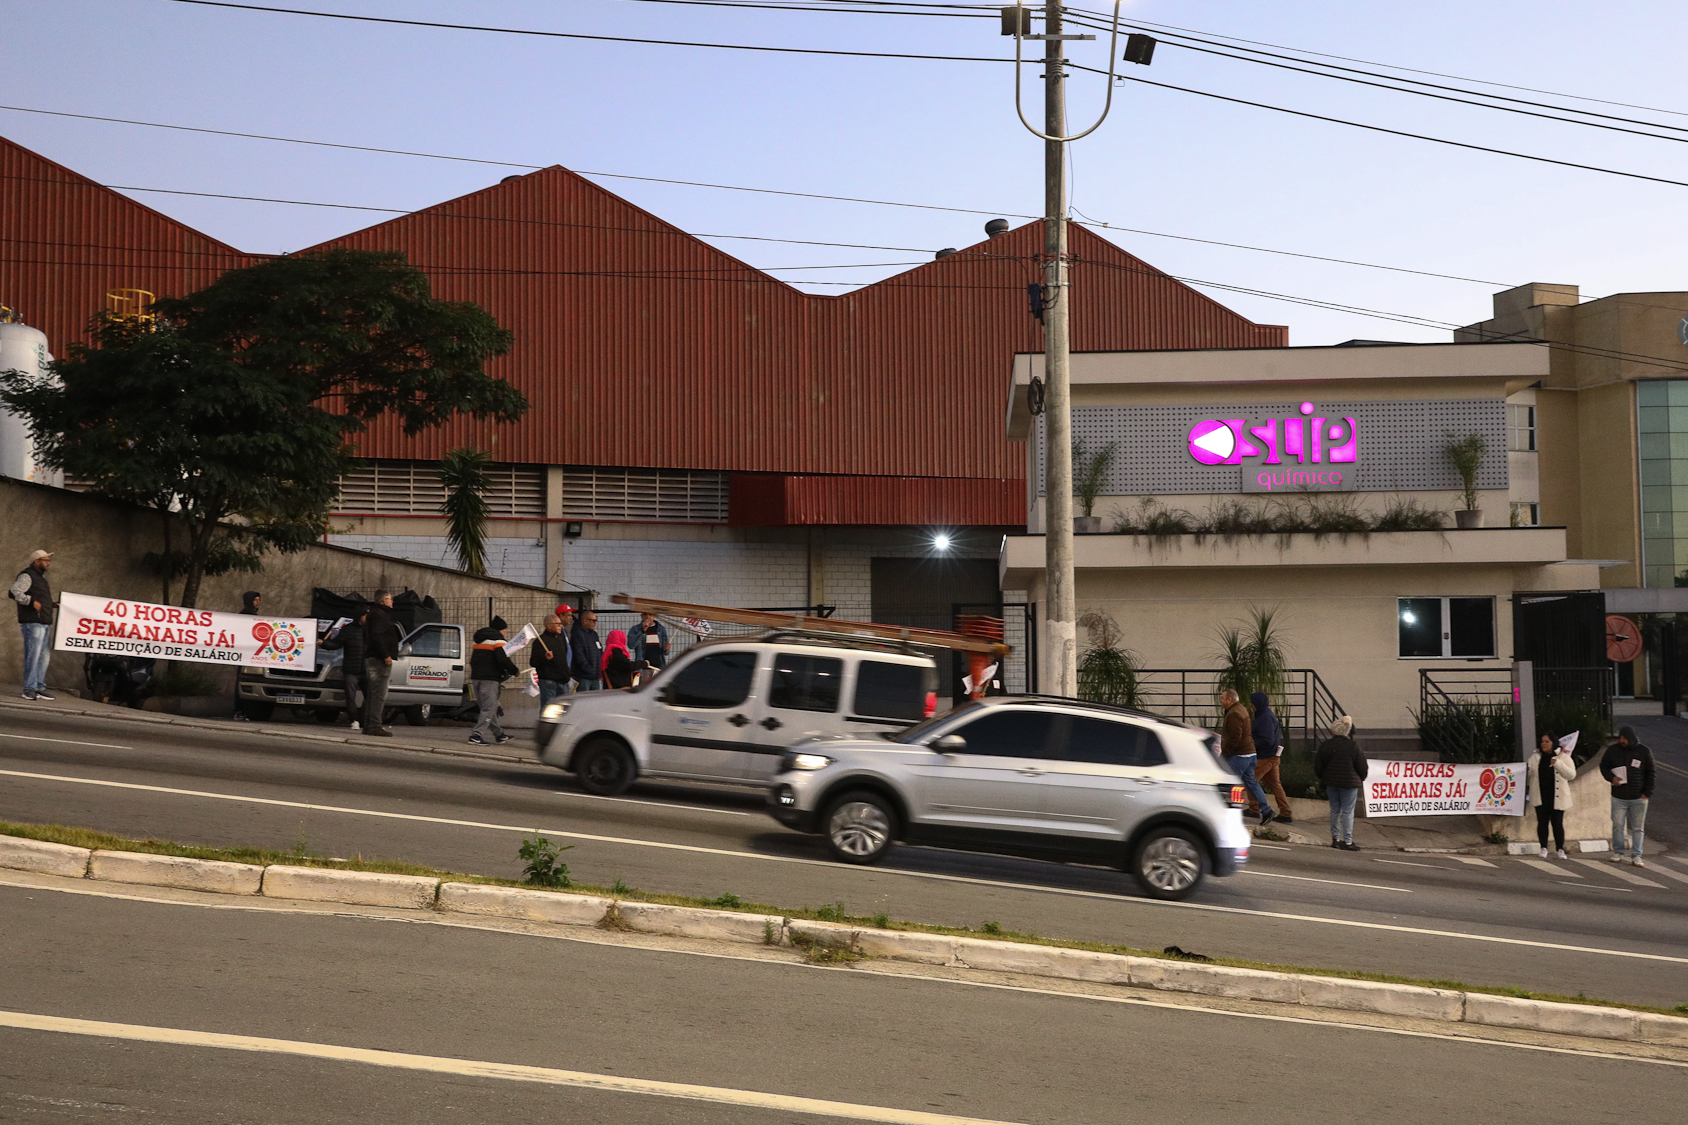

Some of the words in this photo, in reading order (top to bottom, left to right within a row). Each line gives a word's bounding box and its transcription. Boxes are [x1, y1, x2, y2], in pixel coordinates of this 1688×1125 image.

[103, 601, 128, 618] 40
[133, 604, 213, 628] HORAS
[77, 618, 198, 644] SEMANAIS
[203, 629, 236, 649] JÁ!
[65, 637, 94, 650] SEM
[97, 640, 161, 656] REDUÇÃO
[165, 646, 182, 657] DE
[184, 646, 242, 662] SALÁRIO!
[1386, 762, 1400, 778] 40
[1403, 762, 1456, 778] HORAS
[1372, 782, 1443, 800] SEMANAIS
[1445, 778, 1468, 798] JÁ!
[1368, 803, 1382, 813] SEM
[1383, 800, 1420, 813] REDUÇÃO
[1421, 802, 1432, 811] DE
[1433, 799, 1470, 811] SALÁRIO!
